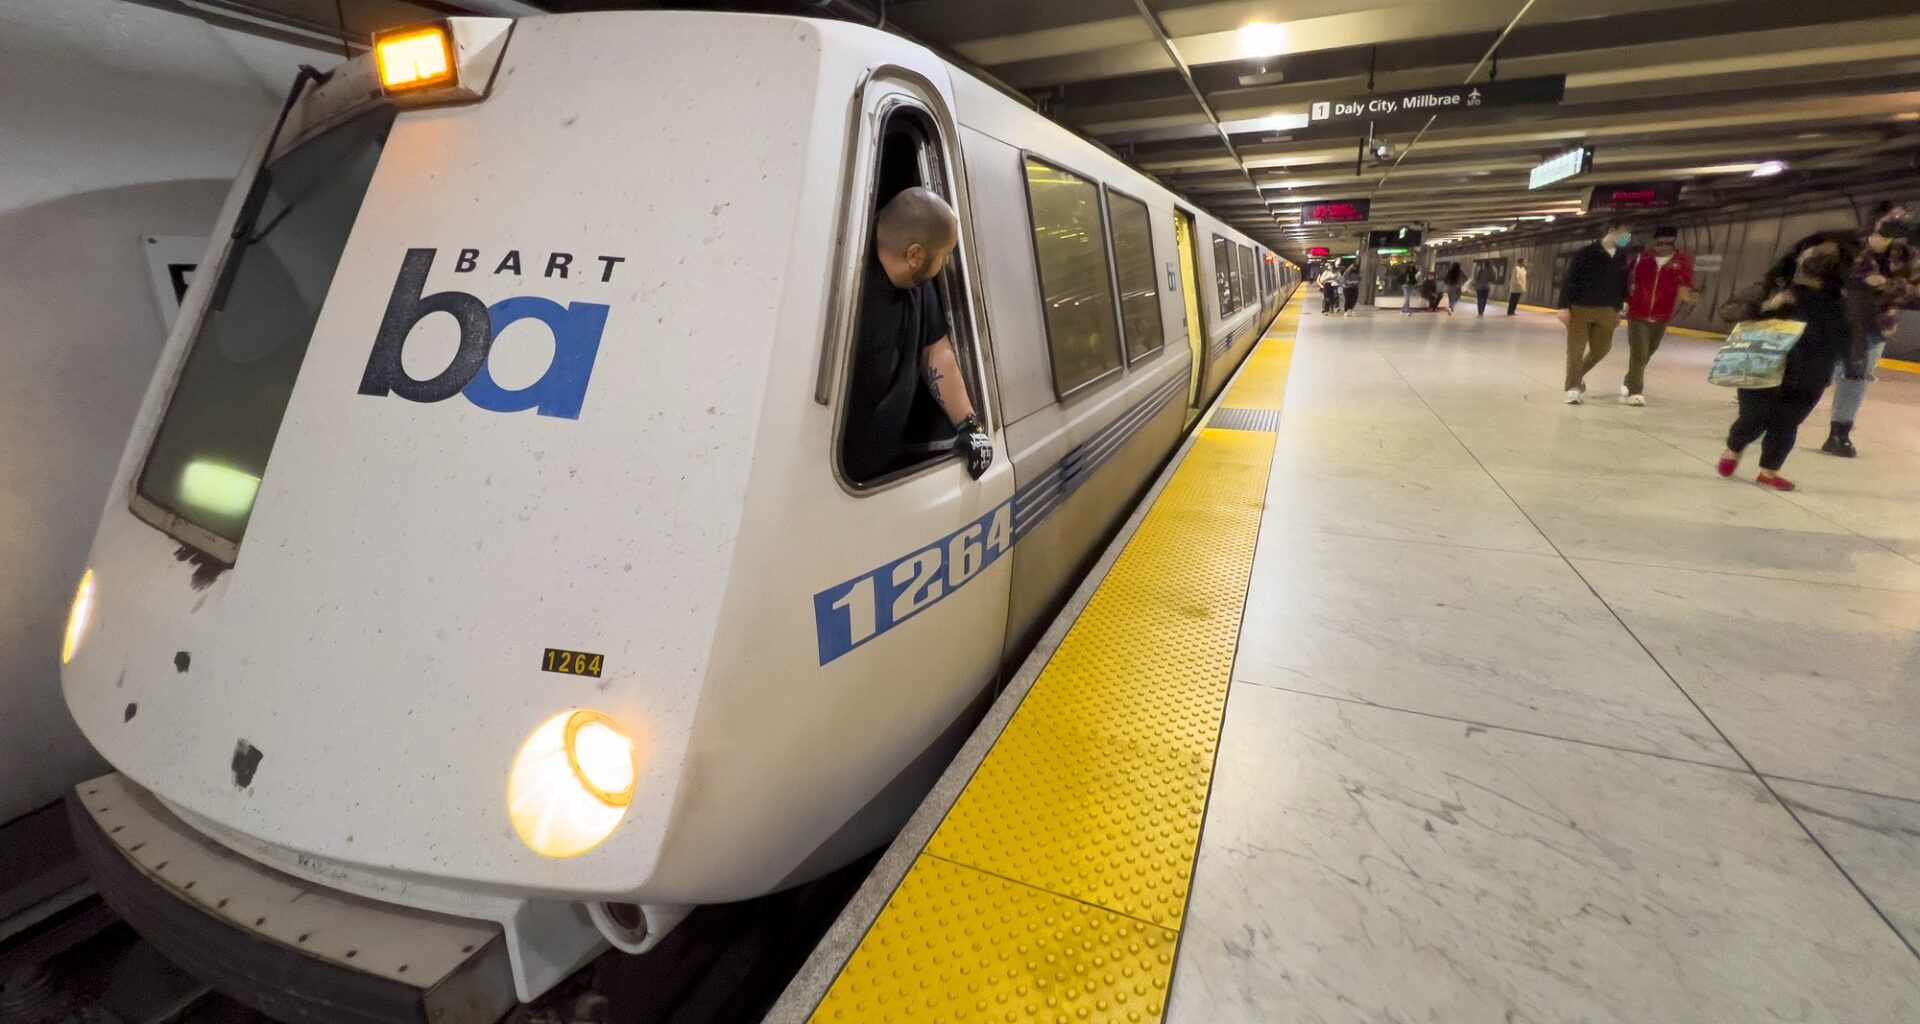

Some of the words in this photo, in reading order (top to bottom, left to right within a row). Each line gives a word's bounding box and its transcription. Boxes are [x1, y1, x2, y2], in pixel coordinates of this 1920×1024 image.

[1335, 101, 1365, 116] Daly
[1368, 99, 1398, 114] City,
[1402, 94, 1461, 109] Millbrae
[454, 248, 626, 283] BART
[357, 247, 611, 421] ba
[831, 501, 1014, 646] 1264
[548, 650, 602, 676] 1264
